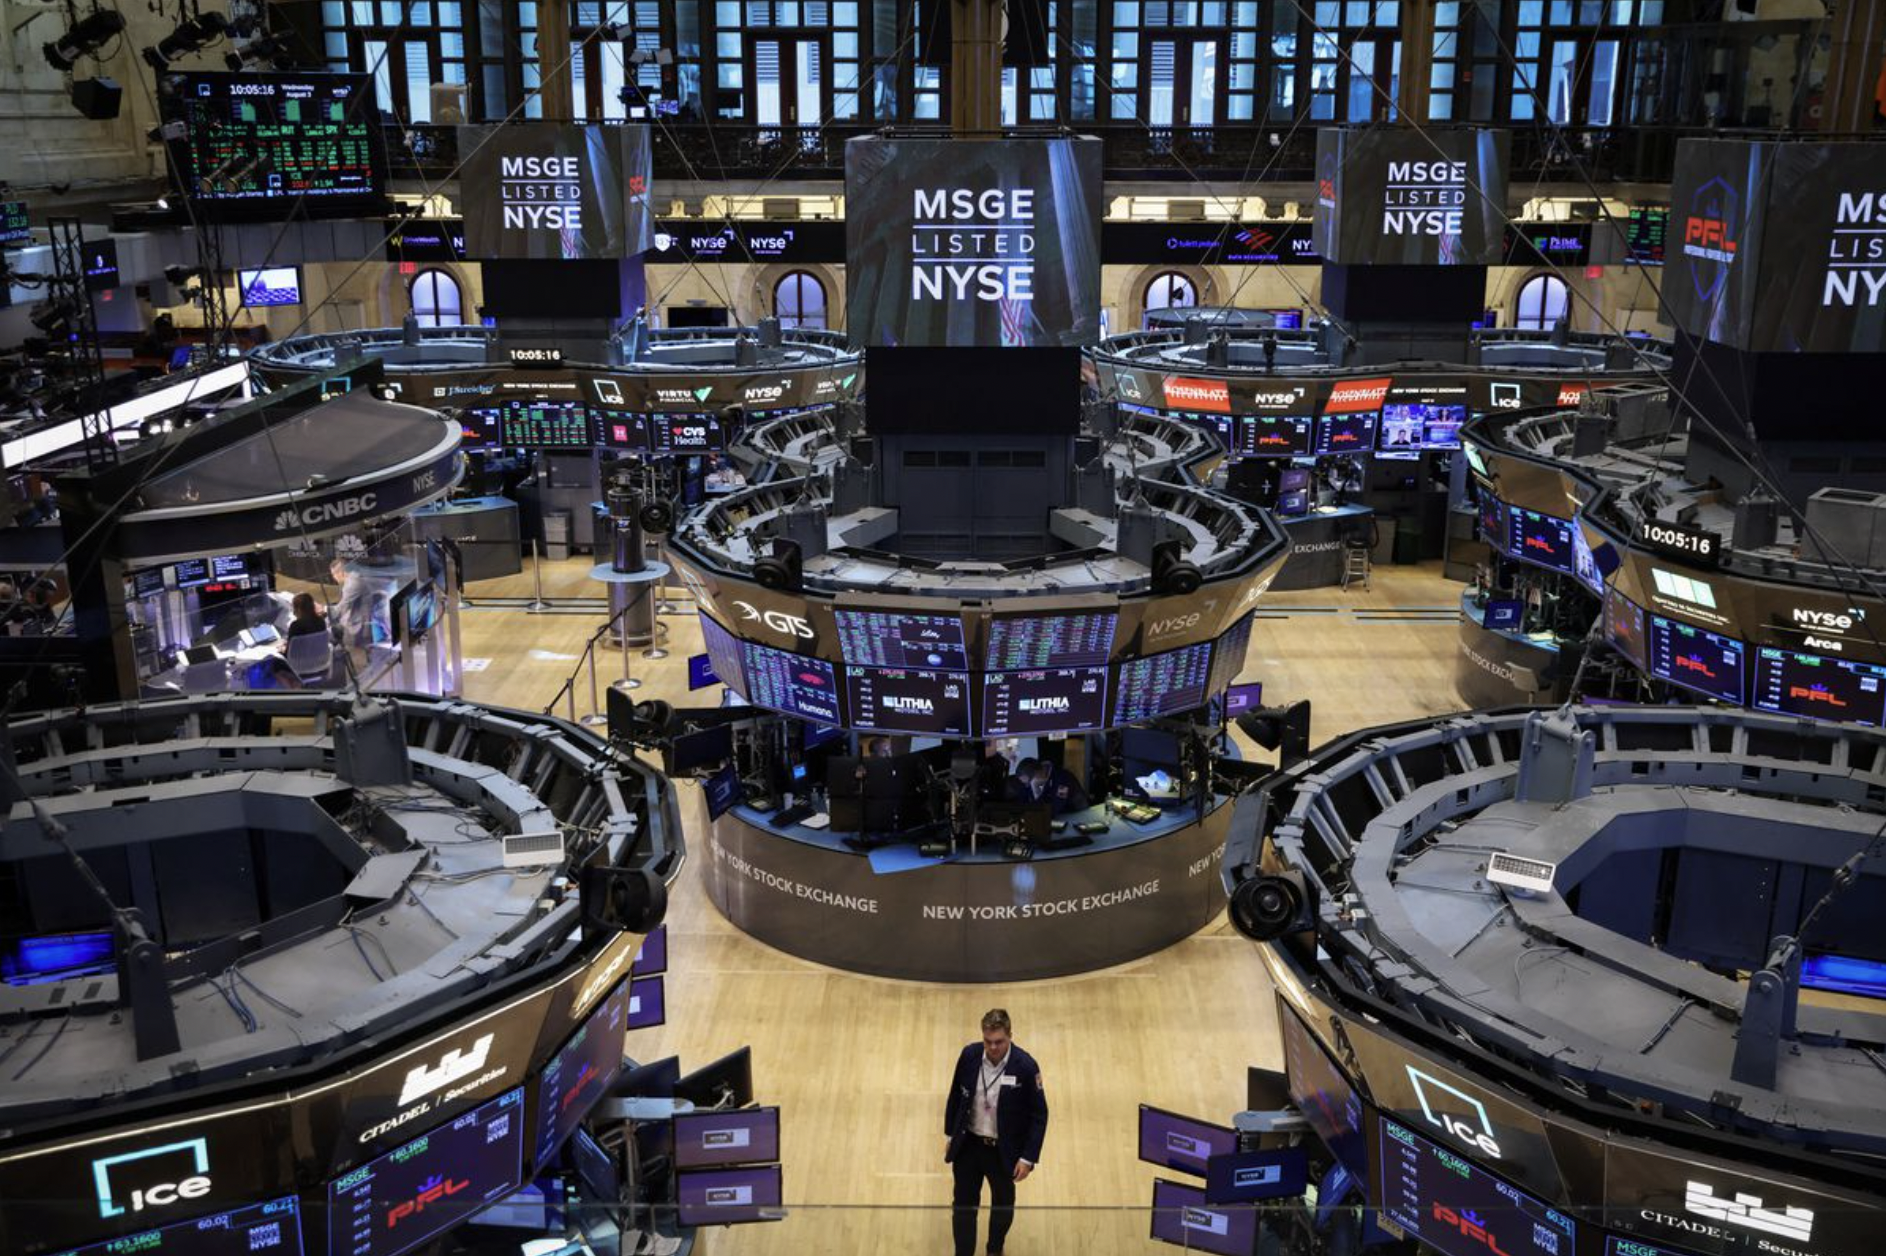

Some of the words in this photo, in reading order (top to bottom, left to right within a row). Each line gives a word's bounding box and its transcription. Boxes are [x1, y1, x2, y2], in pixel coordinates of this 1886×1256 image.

[502, 157, 579, 177] MSGE
[1388, 161, 1467, 182] MSGE
[502, 186, 581, 199] LISTED
[1385, 191, 1466, 204] LISTED
[914, 189, 1035, 220] MSGE
[504, 206, 582, 229] NYSE
[1383, 211, 1464, 235] NYSE
[912, 234, 1035, 253] LISTED
[1292, 240, 1313, 250] NY
[1685, 216, 1737, 252] PFL
[912, 265, 1035, 300] NYSE
[510, 350, 560, 361] 10:05:16
[657, 390, 692, 398] VIRTU
[674, 436, 707, 446] Health
[683, 427, 706, 436] CVS
[303, 493, 377, 525] CNBC
[1643, 523, 1710, 555] 10:05:16
[764, 611, 815, 639] GTS
[1803, 636, 1843, 651] Arca
[894, 697, 934, 710] LITHIA
[1030, 697, 1070, 709] LITHIA
[1790, 686, 1847, 706] PFL
[1188, 855, 1211, 878] NEW
[727, 852, 753, 876] YORK
[753, 867, 794, 894] STOCK
[795, 884, 878, 913] EXCHANGE
[923, 905, 965, 919] NEW
[969, 904, 1017, 919] YORK
[1022, 900, 1078, 918] STOCK
[1081, 879, 1160, 911] EXCHANGE
[359, 1102, 430, 1144] CITADEL
[443, 1066, 508, 1103] Securities
[1387, 1123, 1415, 1145] MSGE
[337, 1167, 371, 1190] MSGE
[388, 1178, 470, 1229] PFL
[1433, 1201, 1512, 1256] PFL
[1641, 1209, 1736, 1241] CITADEL
